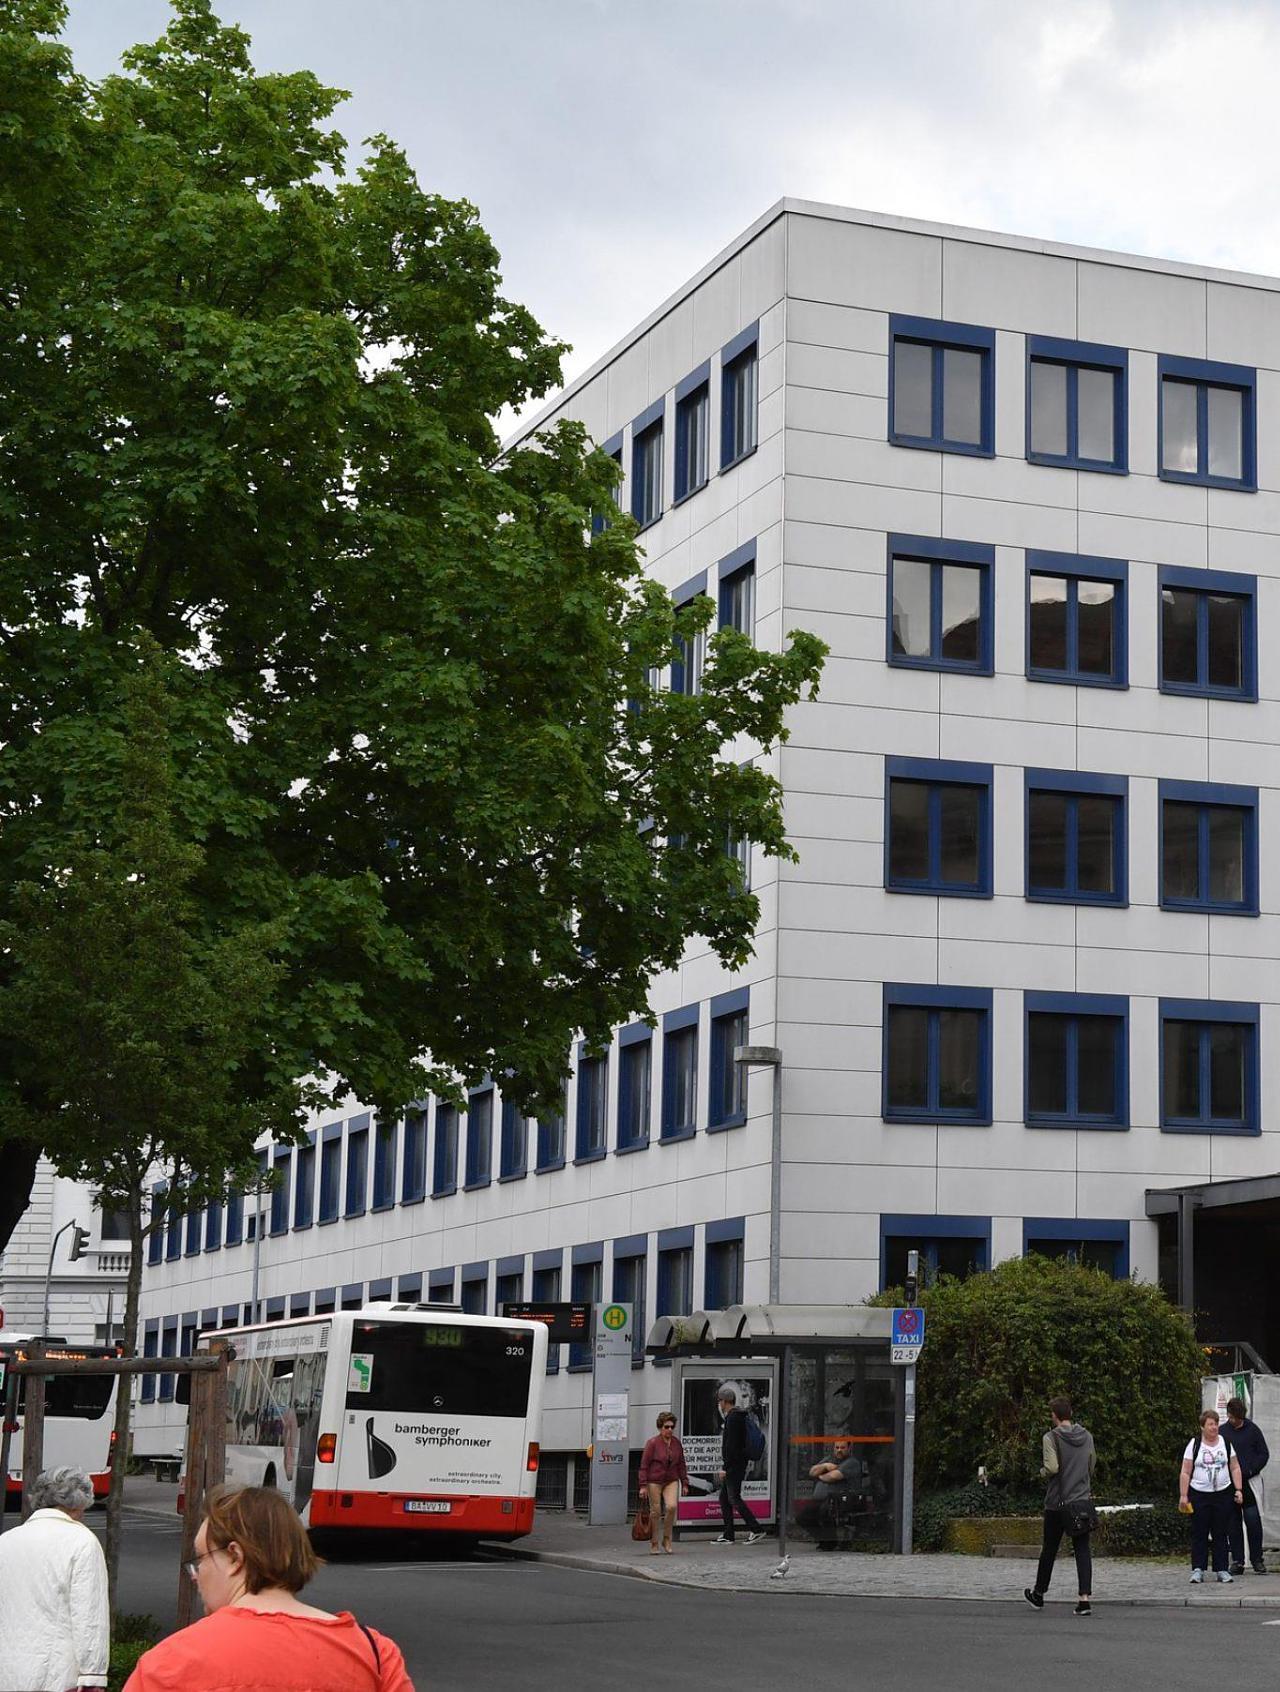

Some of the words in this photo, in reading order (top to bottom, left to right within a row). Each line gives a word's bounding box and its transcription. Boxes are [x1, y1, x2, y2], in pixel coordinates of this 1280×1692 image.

[624, 1334, 632, 1342] N
[896, 1334, 919, 1343] TAXI
[505, 1346, 525, 1356] 320
[394, 1423, 461, 1437] bamberger
[415, 1436, 492, 1448] symphoniker
[694, 1446, 704, 1454] DIE
[447, 1471, 489, 1479] extraordinary
